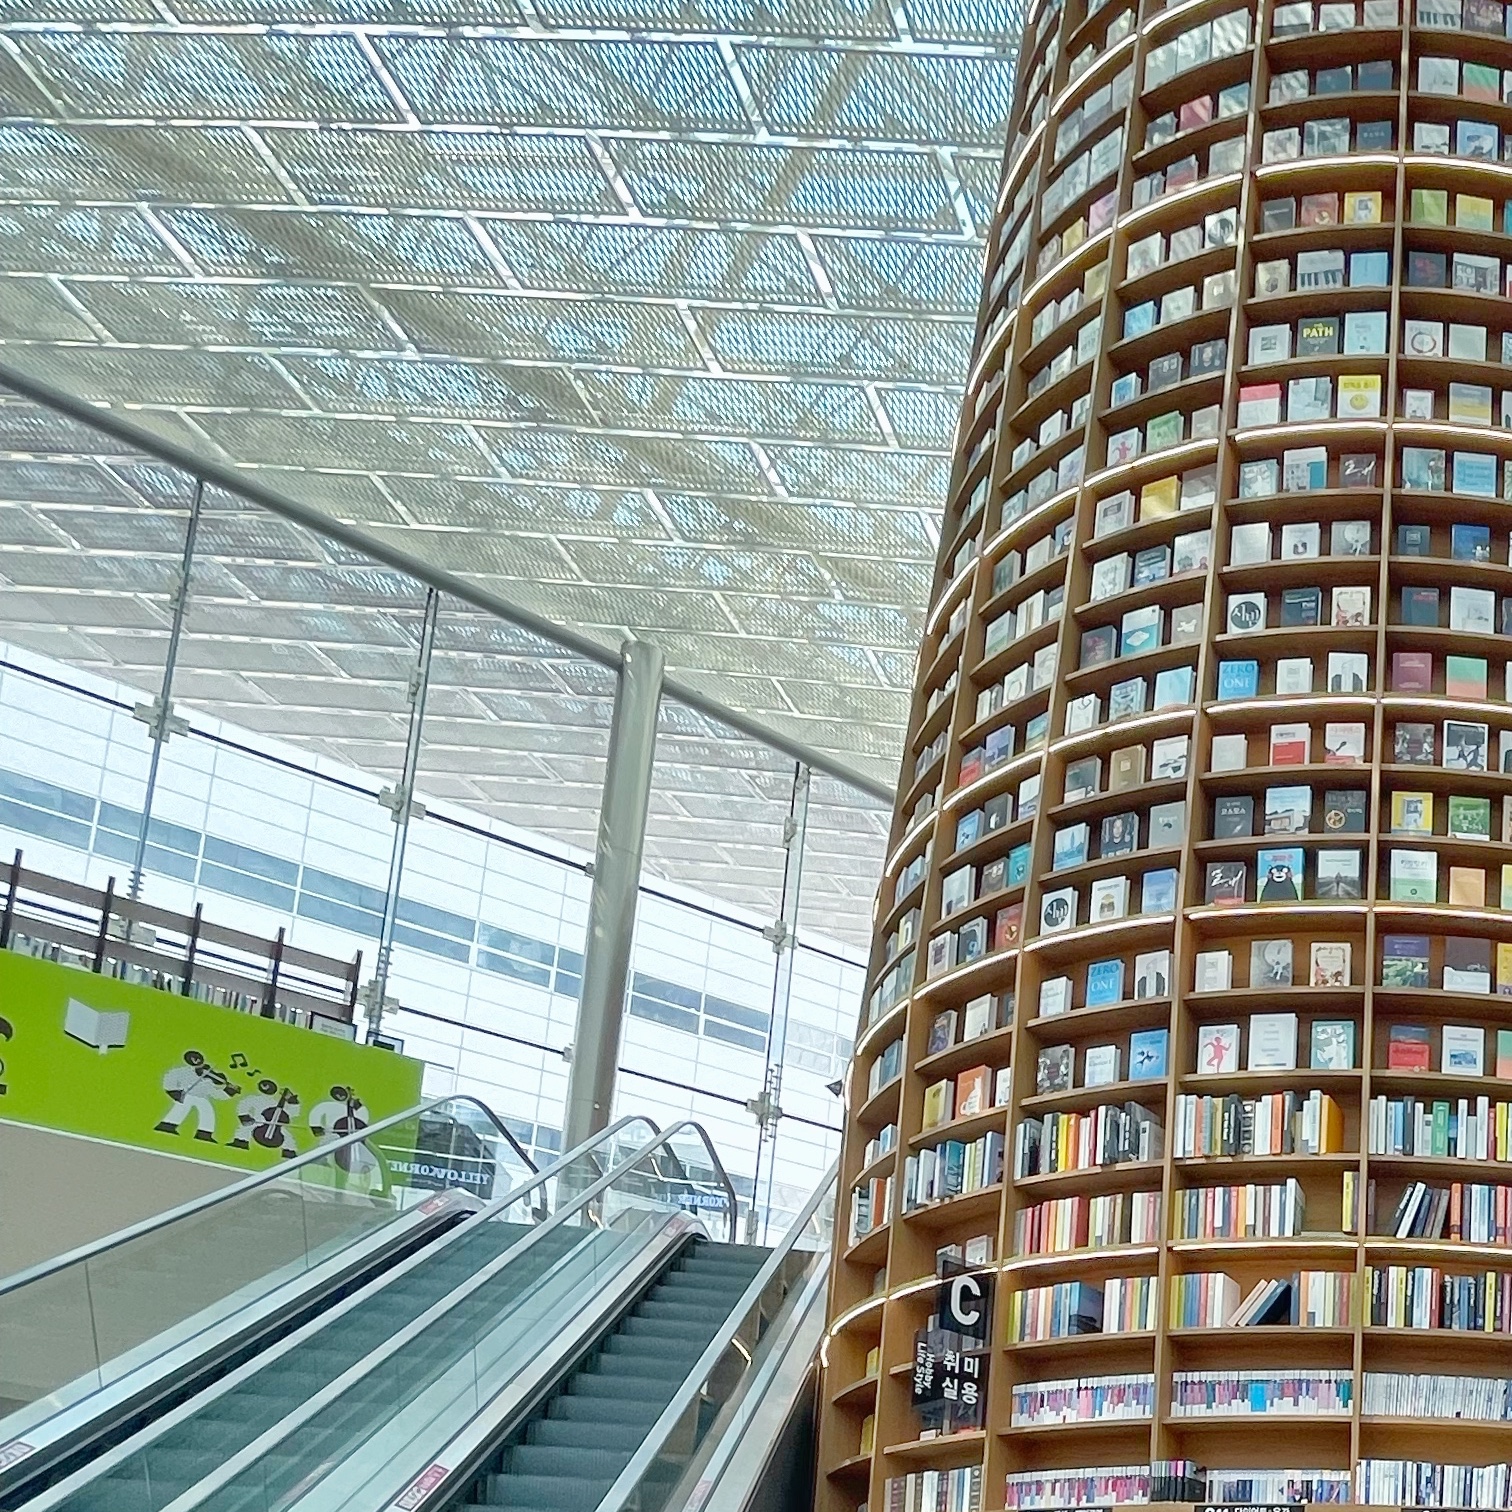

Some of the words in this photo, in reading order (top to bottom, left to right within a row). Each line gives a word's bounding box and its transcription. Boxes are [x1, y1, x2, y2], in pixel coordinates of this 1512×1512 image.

[1303, 327, 1334, 338] PATH
[1222, 664, 1255, 675] ZERO
[1091, 962, 1119, 976] ZERO
[950, 1276, 981, 1326] C
[943, 1350, 979, 1379] 취미
[914, 1366, 926, 1395] Style
[942, 1376, 978, 1404] 실용
